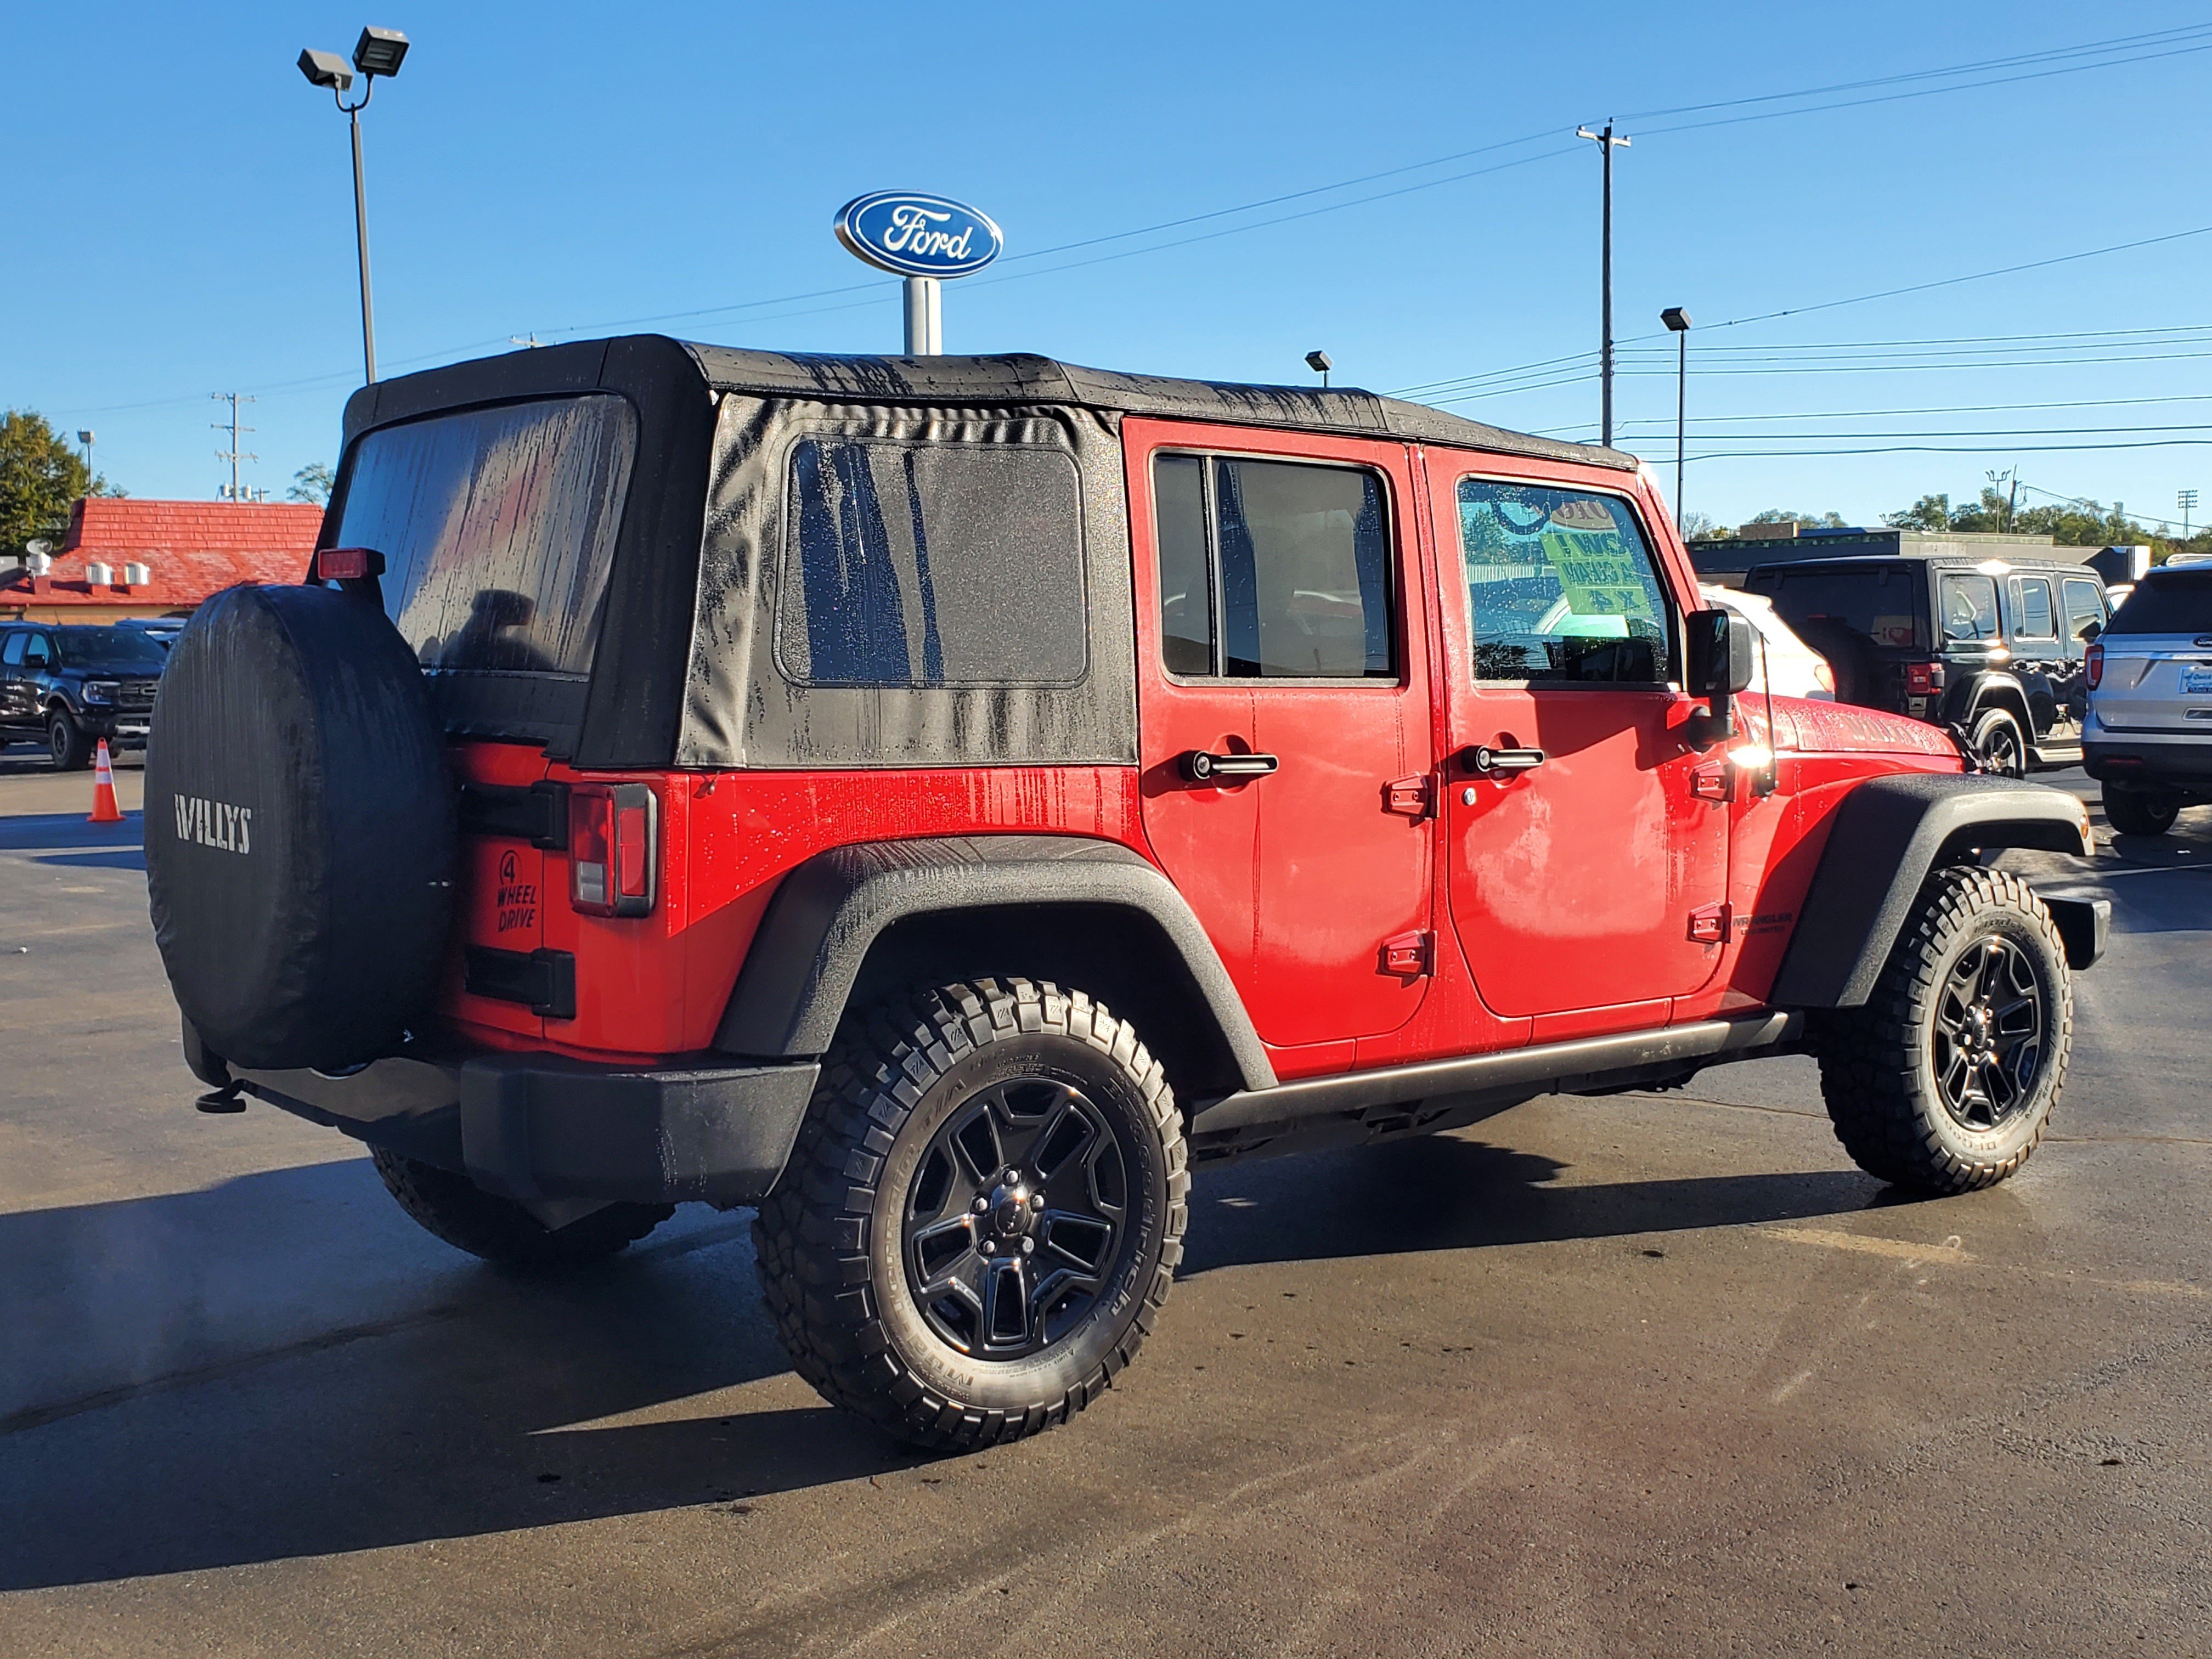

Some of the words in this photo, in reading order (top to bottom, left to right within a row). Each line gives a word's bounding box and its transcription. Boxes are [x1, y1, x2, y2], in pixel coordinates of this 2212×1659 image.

[884, 205, 973, 259] Ford
[174, 793, 252, 854] WILLYS
[504, 855, 515, 884] 4
[498, 884, 536, 907] WHEEL
[498, 908, 536, 932] DRIVE
[1733, 912, 1792, 927] WRANGLER
[1101, 1076, 1155, 1318] BFGoodrich
